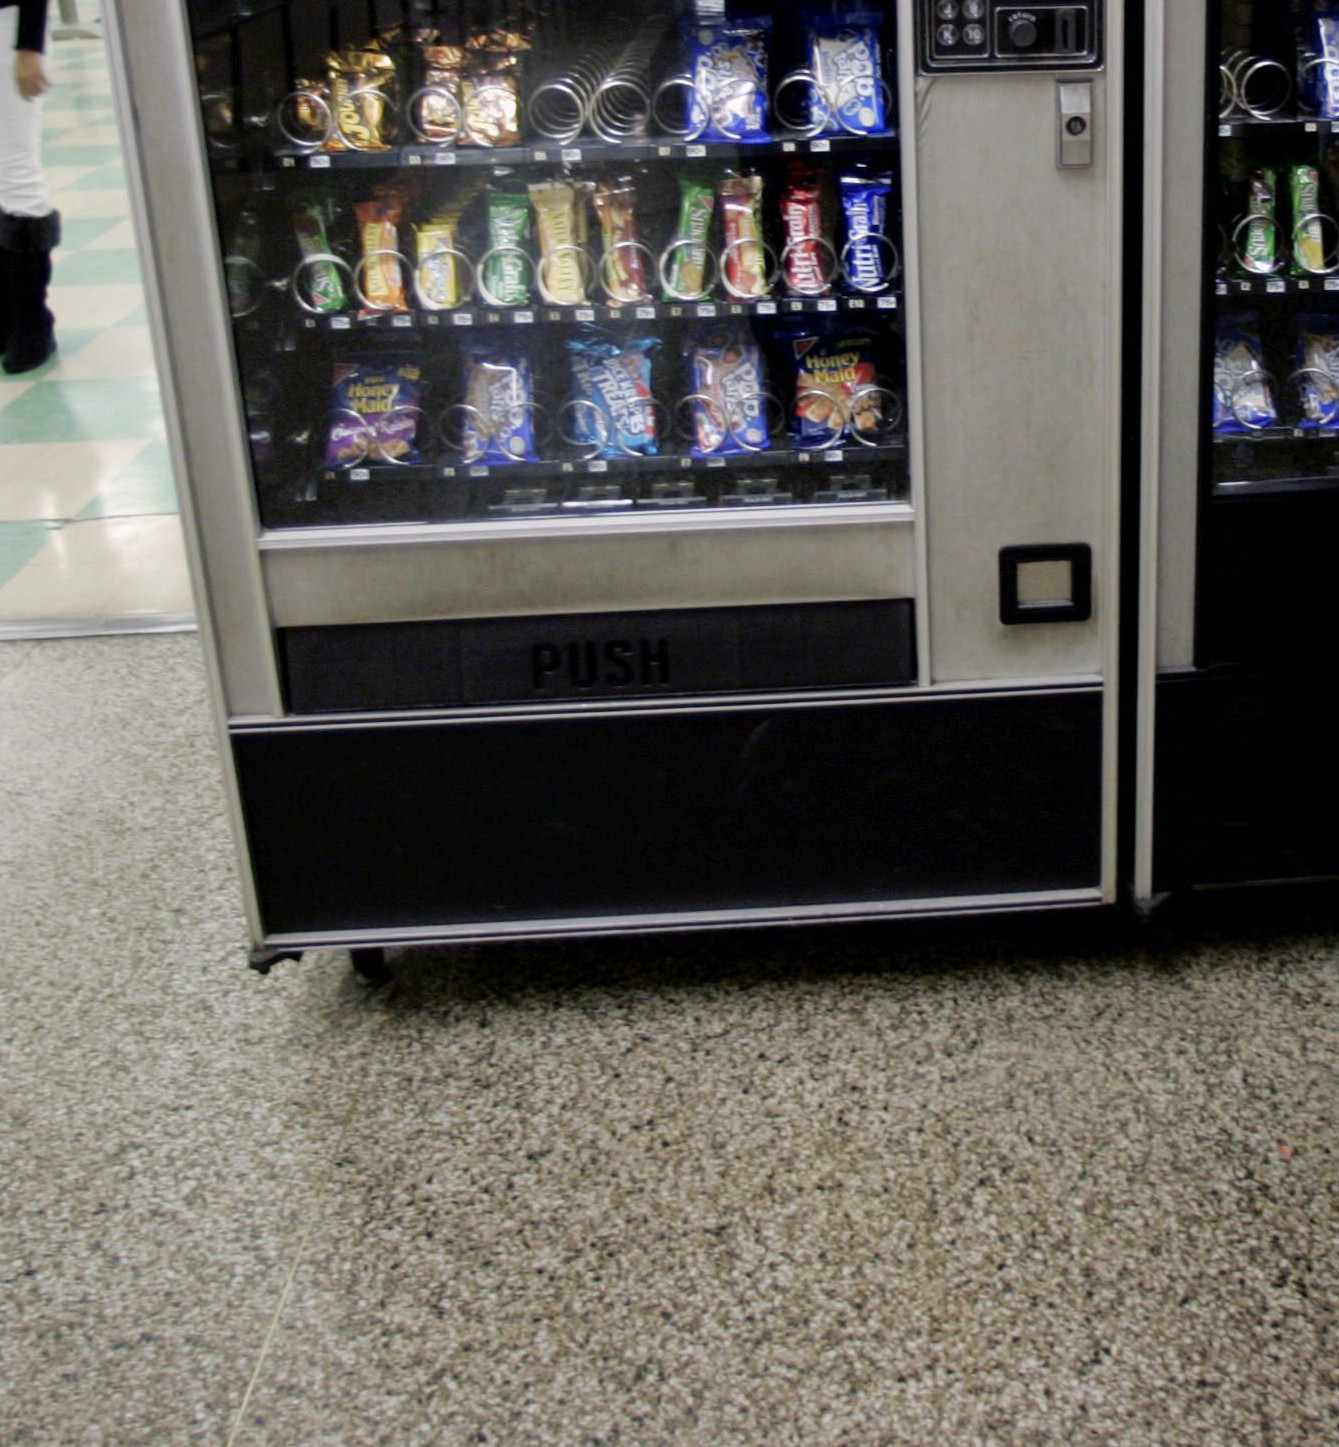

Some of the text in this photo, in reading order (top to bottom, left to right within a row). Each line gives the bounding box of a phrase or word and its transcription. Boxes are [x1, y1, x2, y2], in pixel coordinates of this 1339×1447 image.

[806, 351, 860, 370] Honey
[814, 367, 857, 385] Maid
[533, 638, 671, 691] PUSH
